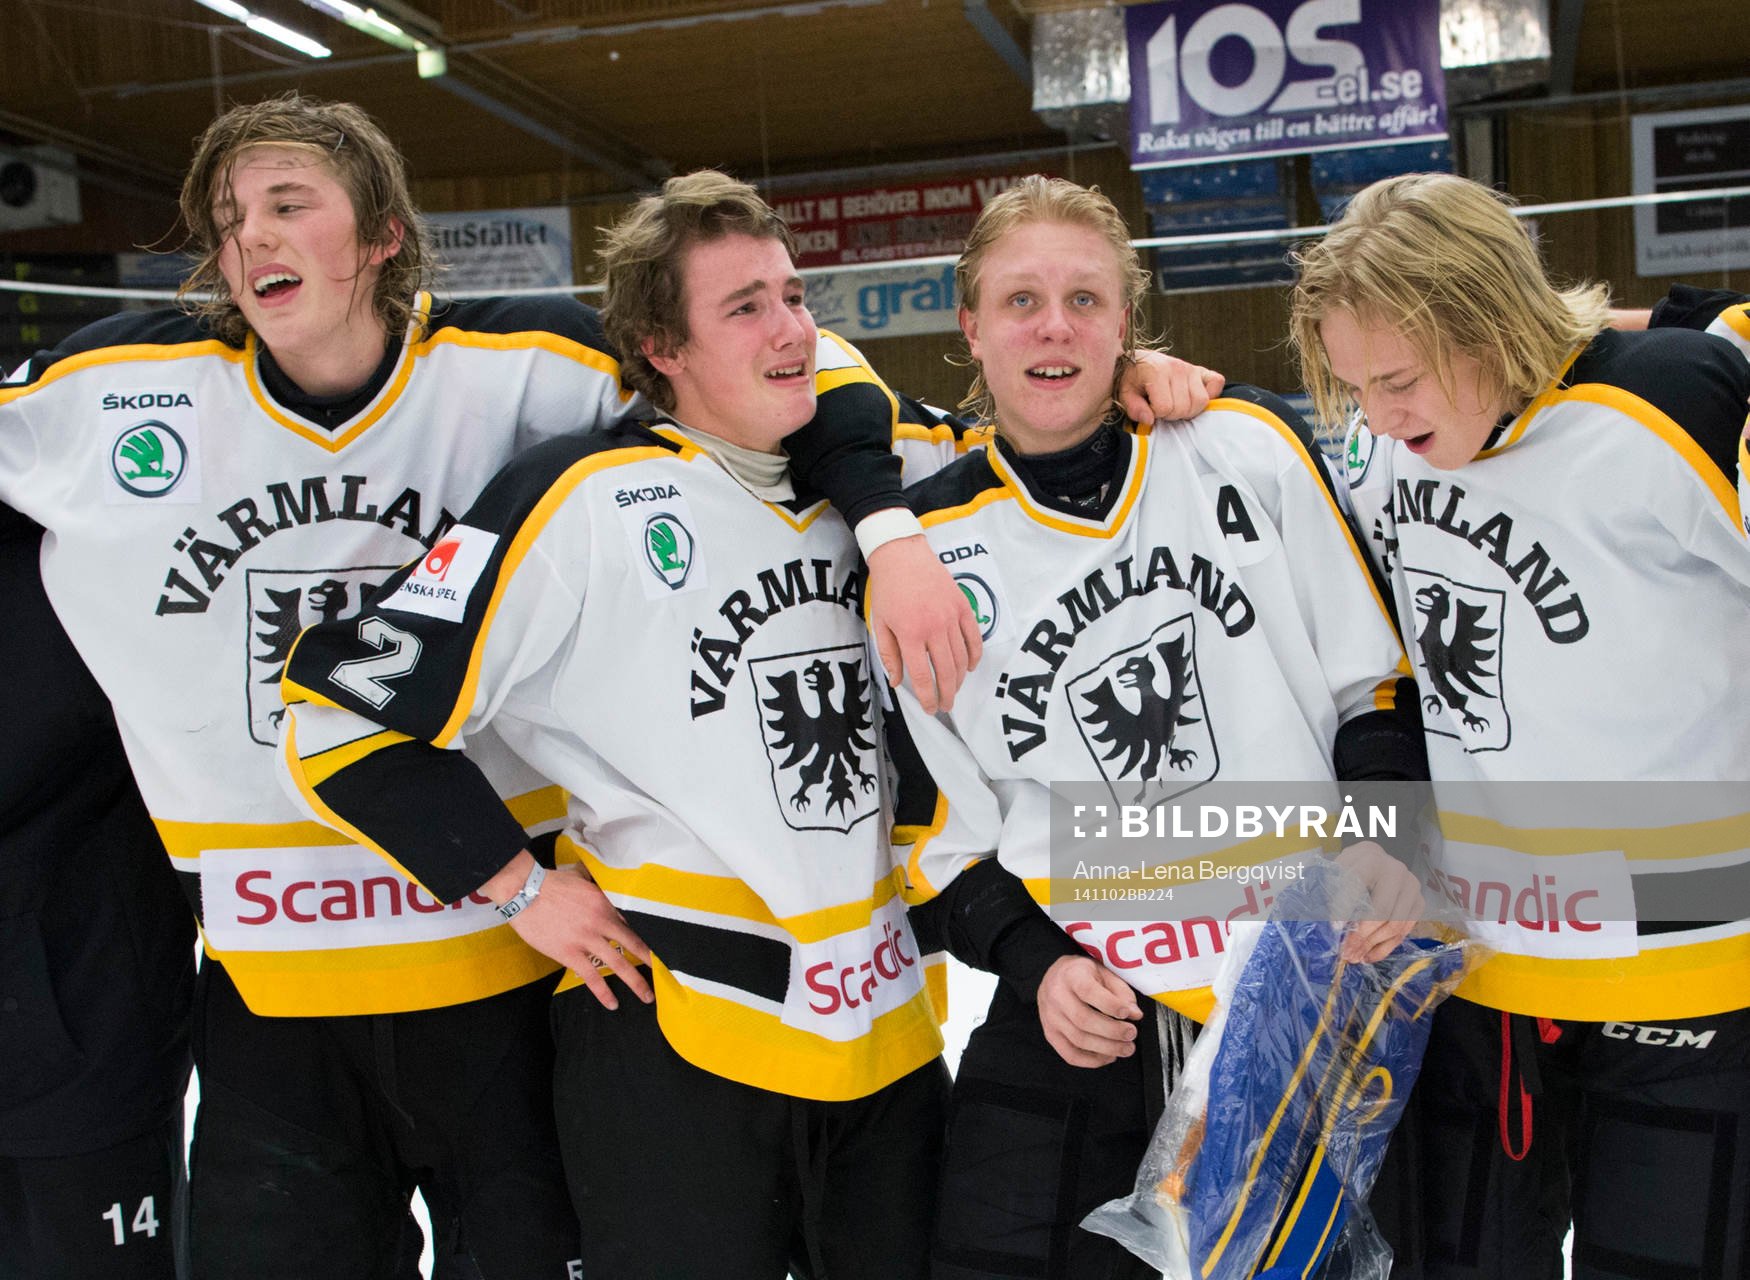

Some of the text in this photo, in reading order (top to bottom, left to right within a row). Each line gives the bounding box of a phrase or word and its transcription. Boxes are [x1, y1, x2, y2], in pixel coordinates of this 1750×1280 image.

[1138, 103, 1439, 154] Raka vägen till en bättre affär!
[842, 189, 920, 218] BEHÖVER
[924, 184, 973, 210] INOM
[102, 392, 194, 411] ŠKODA
[614, 484, 683, 509] ŠKODA
[1216, 484, 1260, 543] A
[328, 615, 424, 711] 2
[995, 546, 1256, 763] VÄRMLAND
[235, 870, 492, 926] Scand
[1601, 1021, 1718, 1049] CCM
[102, 1195, 159, 1246] 14
